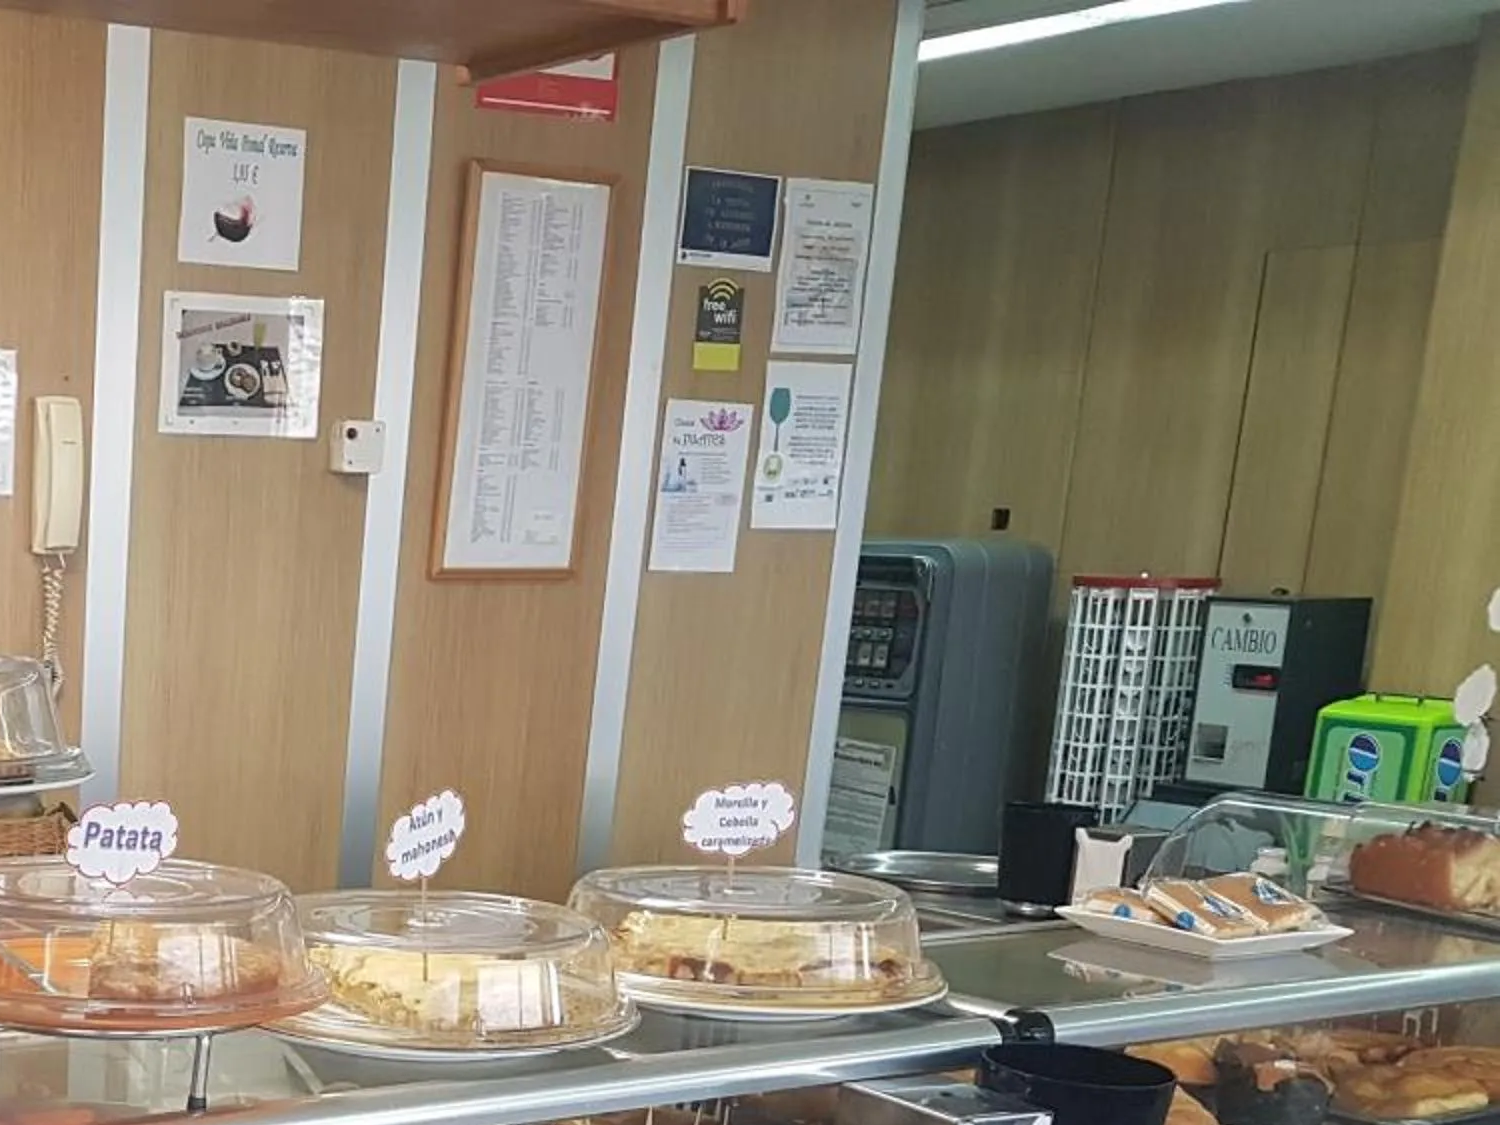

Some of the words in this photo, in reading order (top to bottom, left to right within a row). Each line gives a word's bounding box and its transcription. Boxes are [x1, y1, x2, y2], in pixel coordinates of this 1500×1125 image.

[703, 297, 726, 311] free
[713, 309, 738, 325] wifi
[1211, 626, 1277, 654] CAMBIO
[83, 821, 163, 851] Patata
